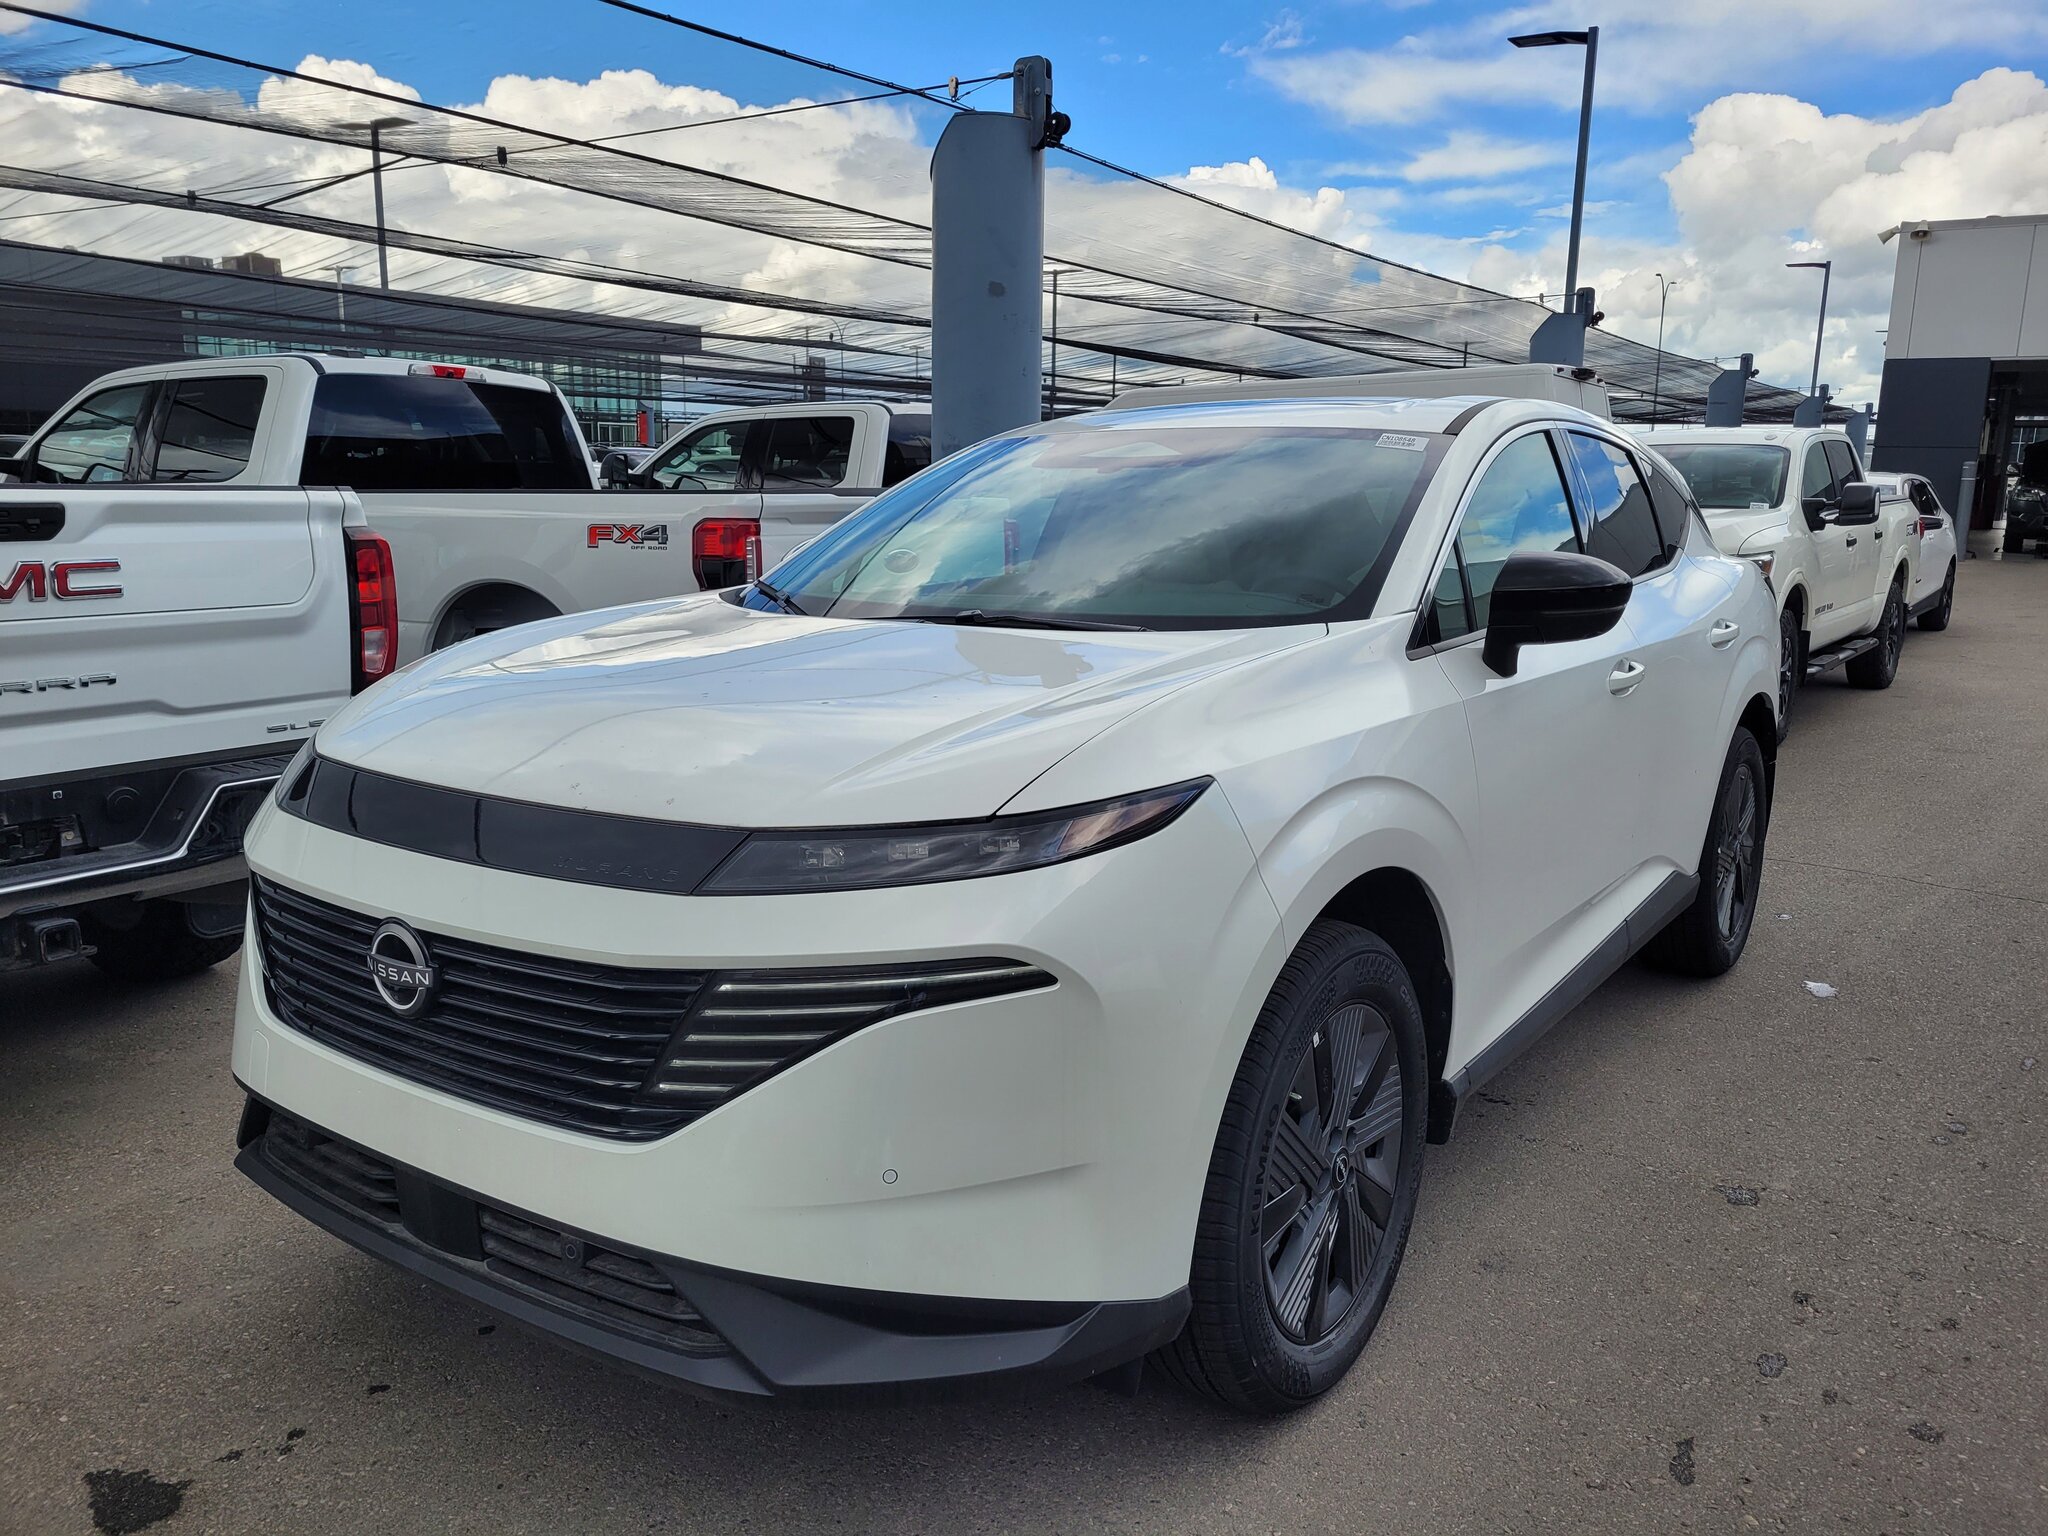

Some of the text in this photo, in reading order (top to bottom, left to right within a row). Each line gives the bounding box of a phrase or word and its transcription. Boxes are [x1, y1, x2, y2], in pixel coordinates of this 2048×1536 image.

[587, 523, 668, 548] FX4
[367, 955, 429, 985] NISSAN
[1249, 1104, 1279, 1236] KUMHO
